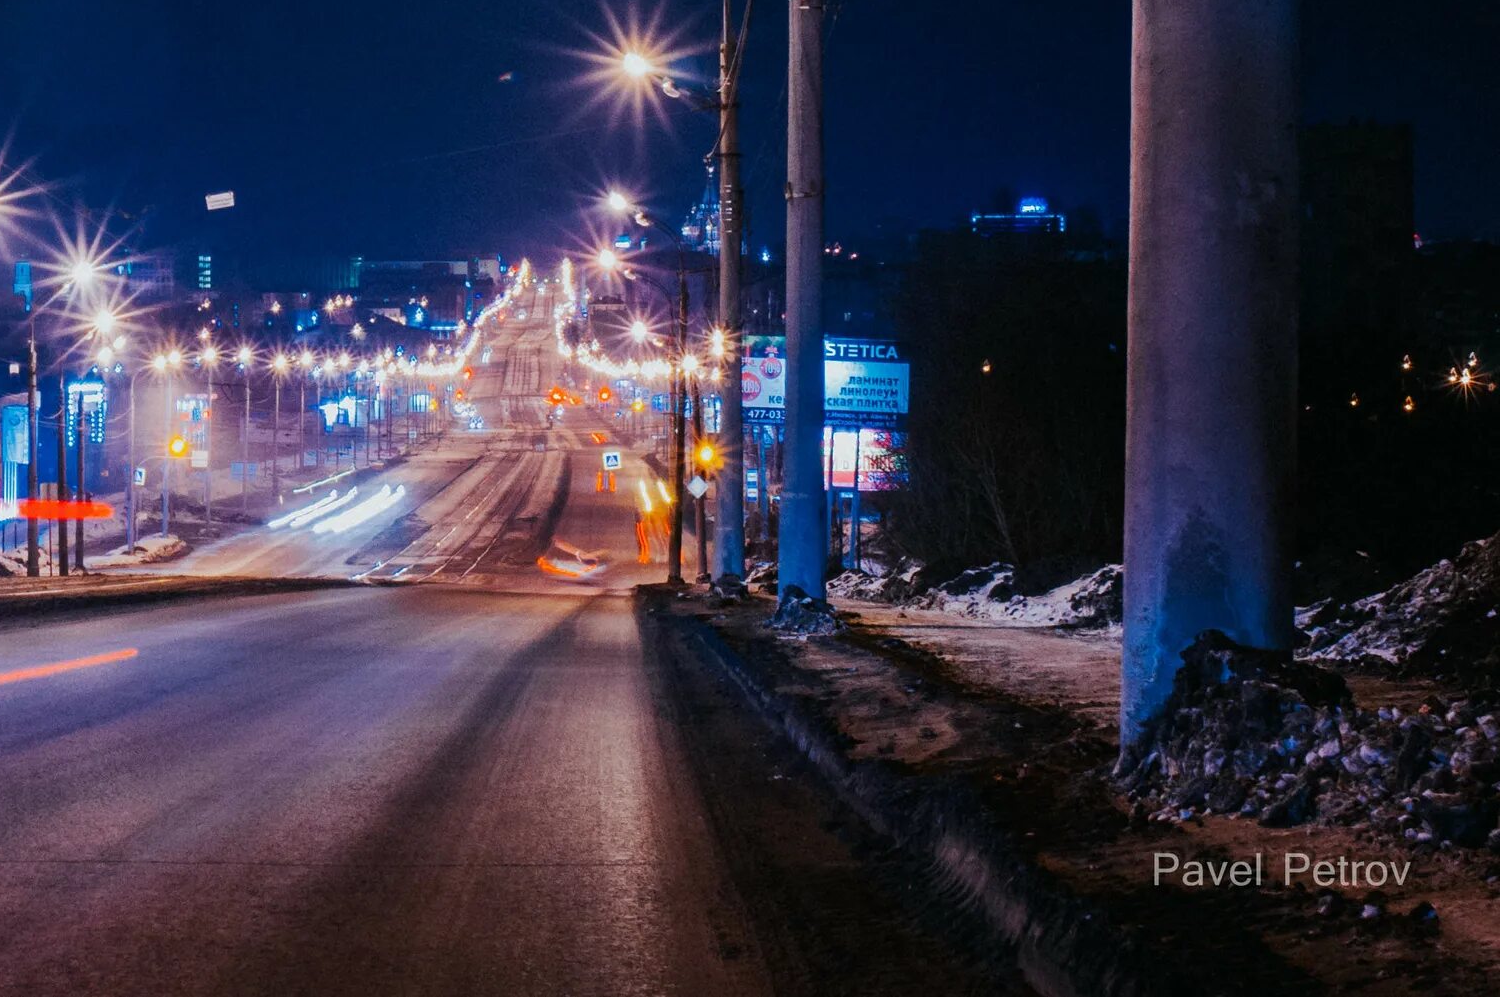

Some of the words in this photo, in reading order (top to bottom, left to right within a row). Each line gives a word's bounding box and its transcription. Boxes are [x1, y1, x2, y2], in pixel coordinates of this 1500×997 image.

[848, 376, 899, 386] ламинат
[839, 387, 899, 399] линолеум
[768, 395, 785, 405] ке
[826, 397, 853, 407] ская
[857, 398, 899, 409] плитка
